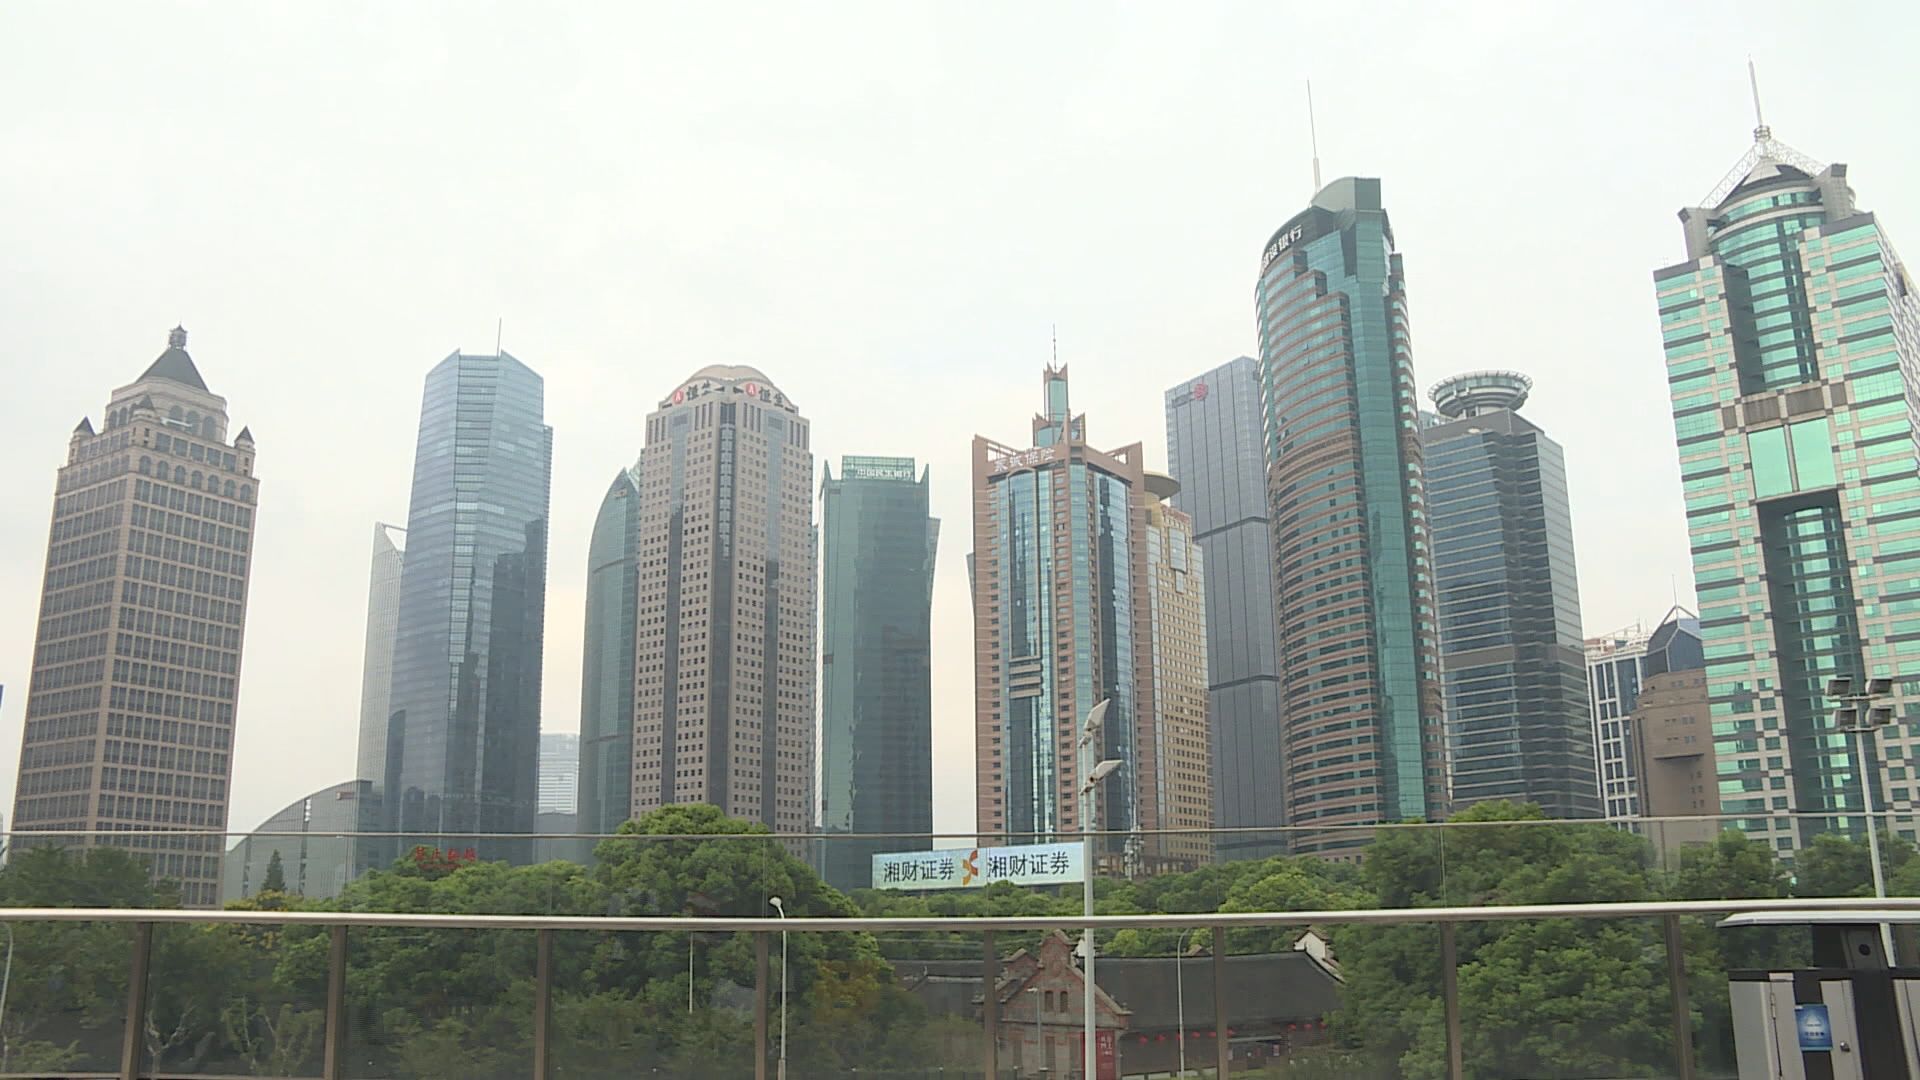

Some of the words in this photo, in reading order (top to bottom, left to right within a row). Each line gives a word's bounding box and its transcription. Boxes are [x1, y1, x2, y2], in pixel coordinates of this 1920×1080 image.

[883, 857, 955, 883] 湘财证券
[988, 850, 1070, 878] 湘财证券
